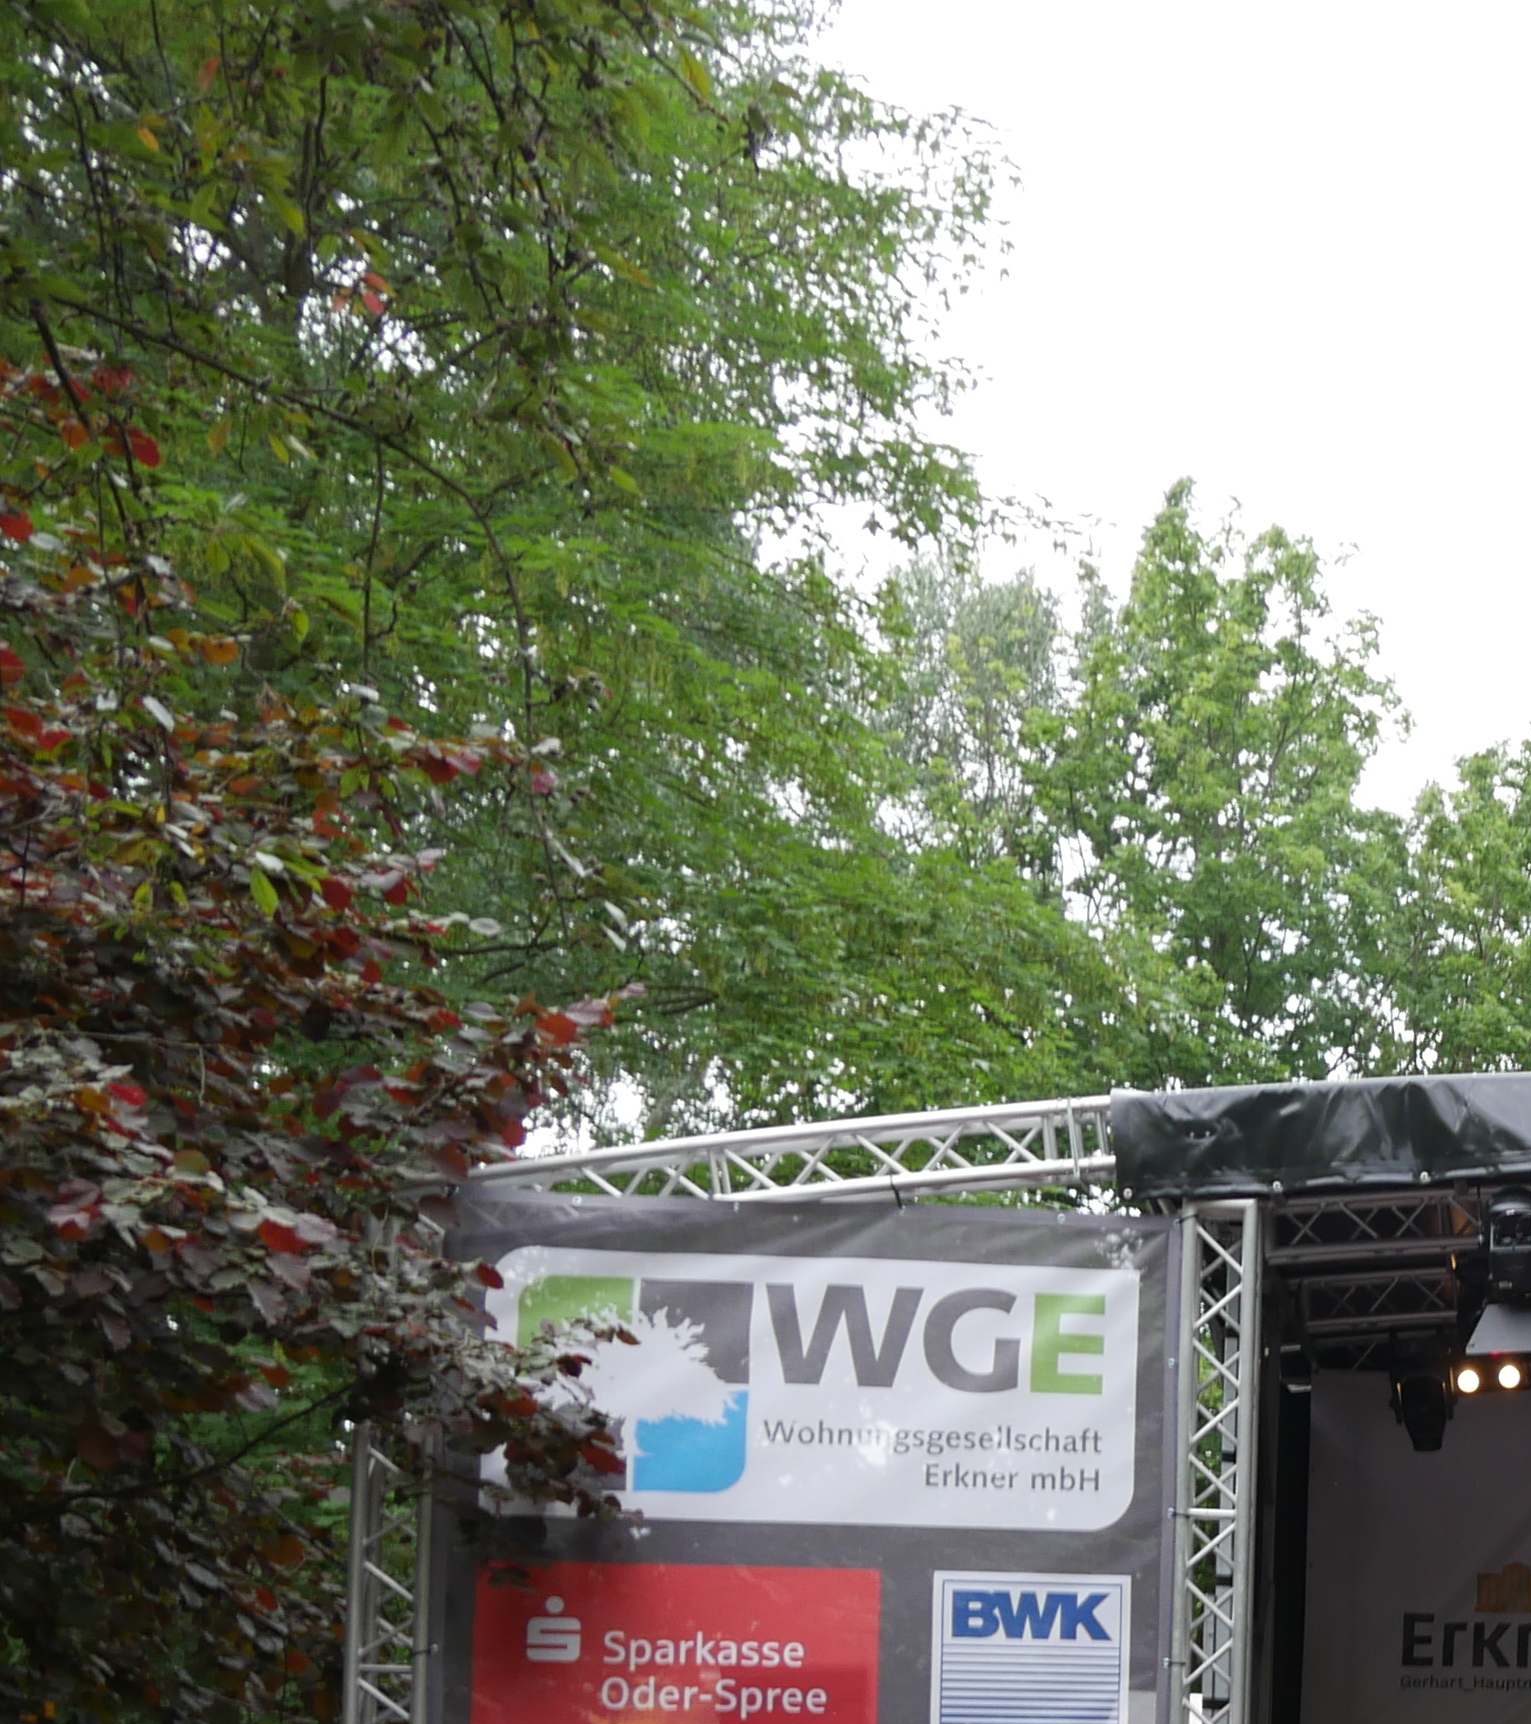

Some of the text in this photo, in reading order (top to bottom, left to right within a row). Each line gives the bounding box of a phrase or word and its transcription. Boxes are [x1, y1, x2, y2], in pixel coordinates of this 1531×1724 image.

[764, 1282, 1106, 1396] WGE
[924, 1463, 1101, 1492] Erkner mbH
[950, 1589, 1112, 1642] BWK
[603, 1631, 805, 1671] Sparkasse
[600, 1676, 828, 1721] Oder-Spree
